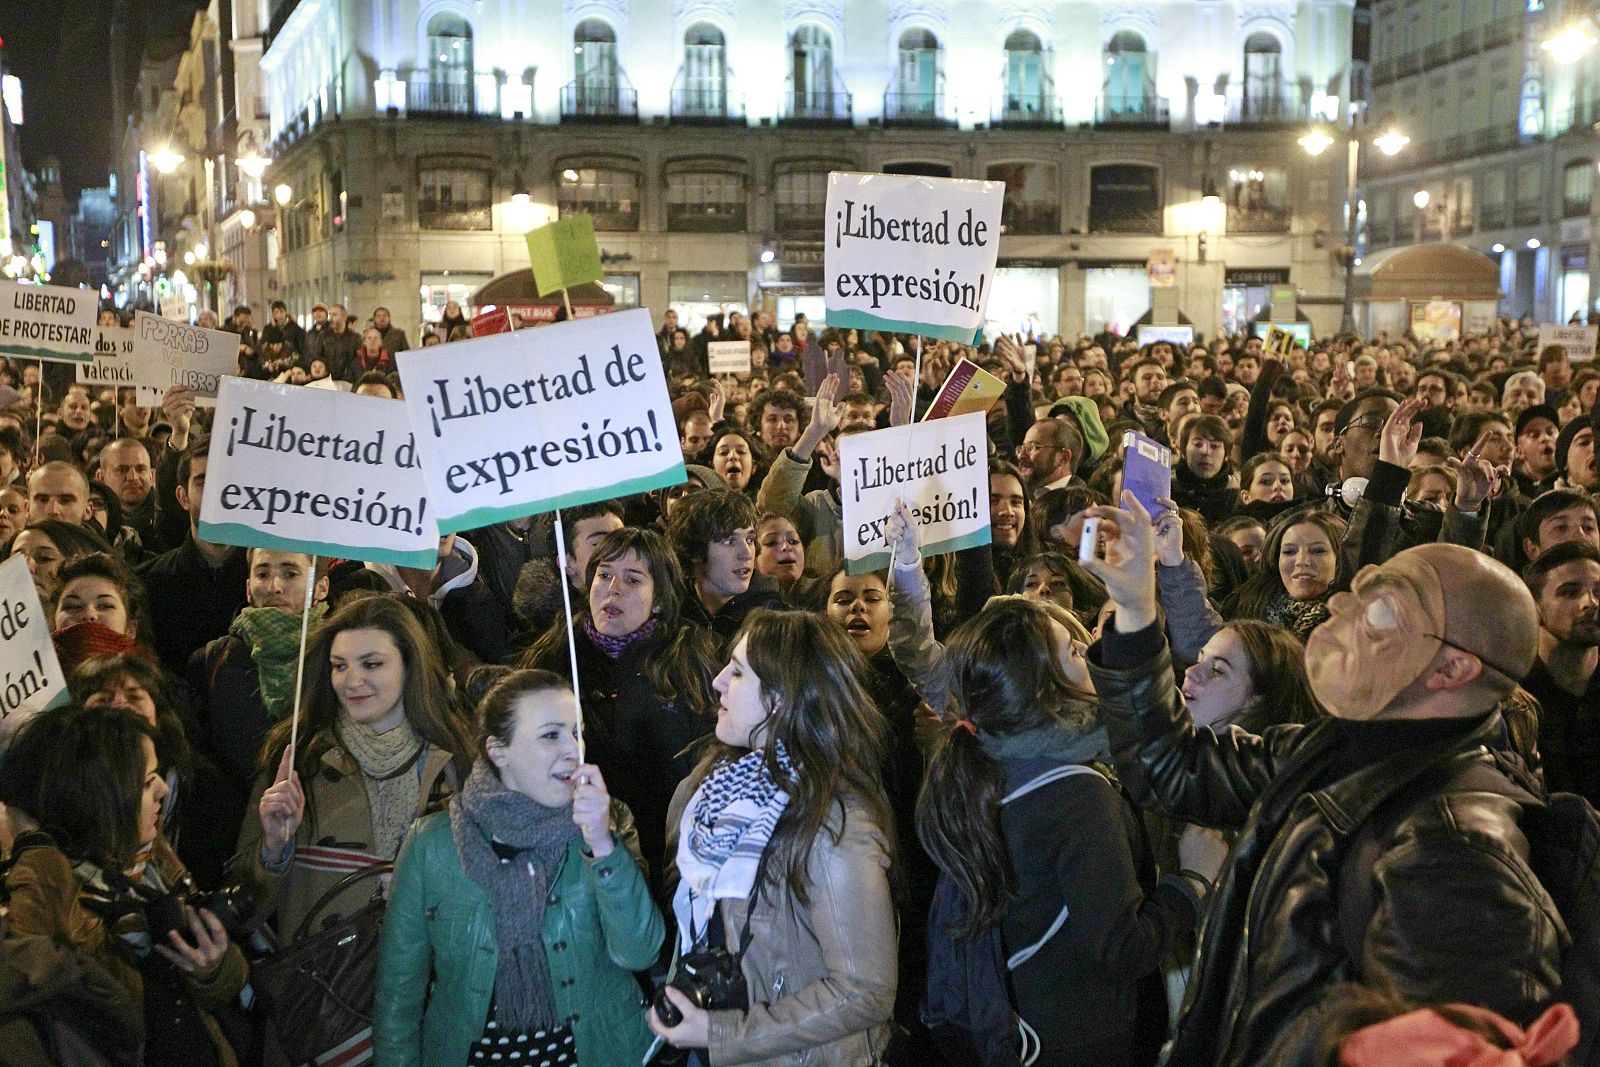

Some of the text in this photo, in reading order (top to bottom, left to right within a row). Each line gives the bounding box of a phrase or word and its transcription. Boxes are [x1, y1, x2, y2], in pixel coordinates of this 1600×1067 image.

[836, 199, 988, 248] ¡Libertad de
[14, 291, 76, 316] LIBERTAD
[534, 307, 553, 318] BUS
[836, 268, 985, 313] expresión!
[0, 318, 92, 345] E PROTESTAR!
[94, 333, 134, 353] dos so
[141, 316, 210, 354] PORRAS
[427, 344, 648, 437] ¡Libertad de
[226, 406, 422, 470] ¡Libertad d
[445, 409, 664, 496] expresión!
[853, 437, 977, 502] ¡Libertad de
[220, 482, 428, 536] expresión!
[0, 598, 30, 641] de
